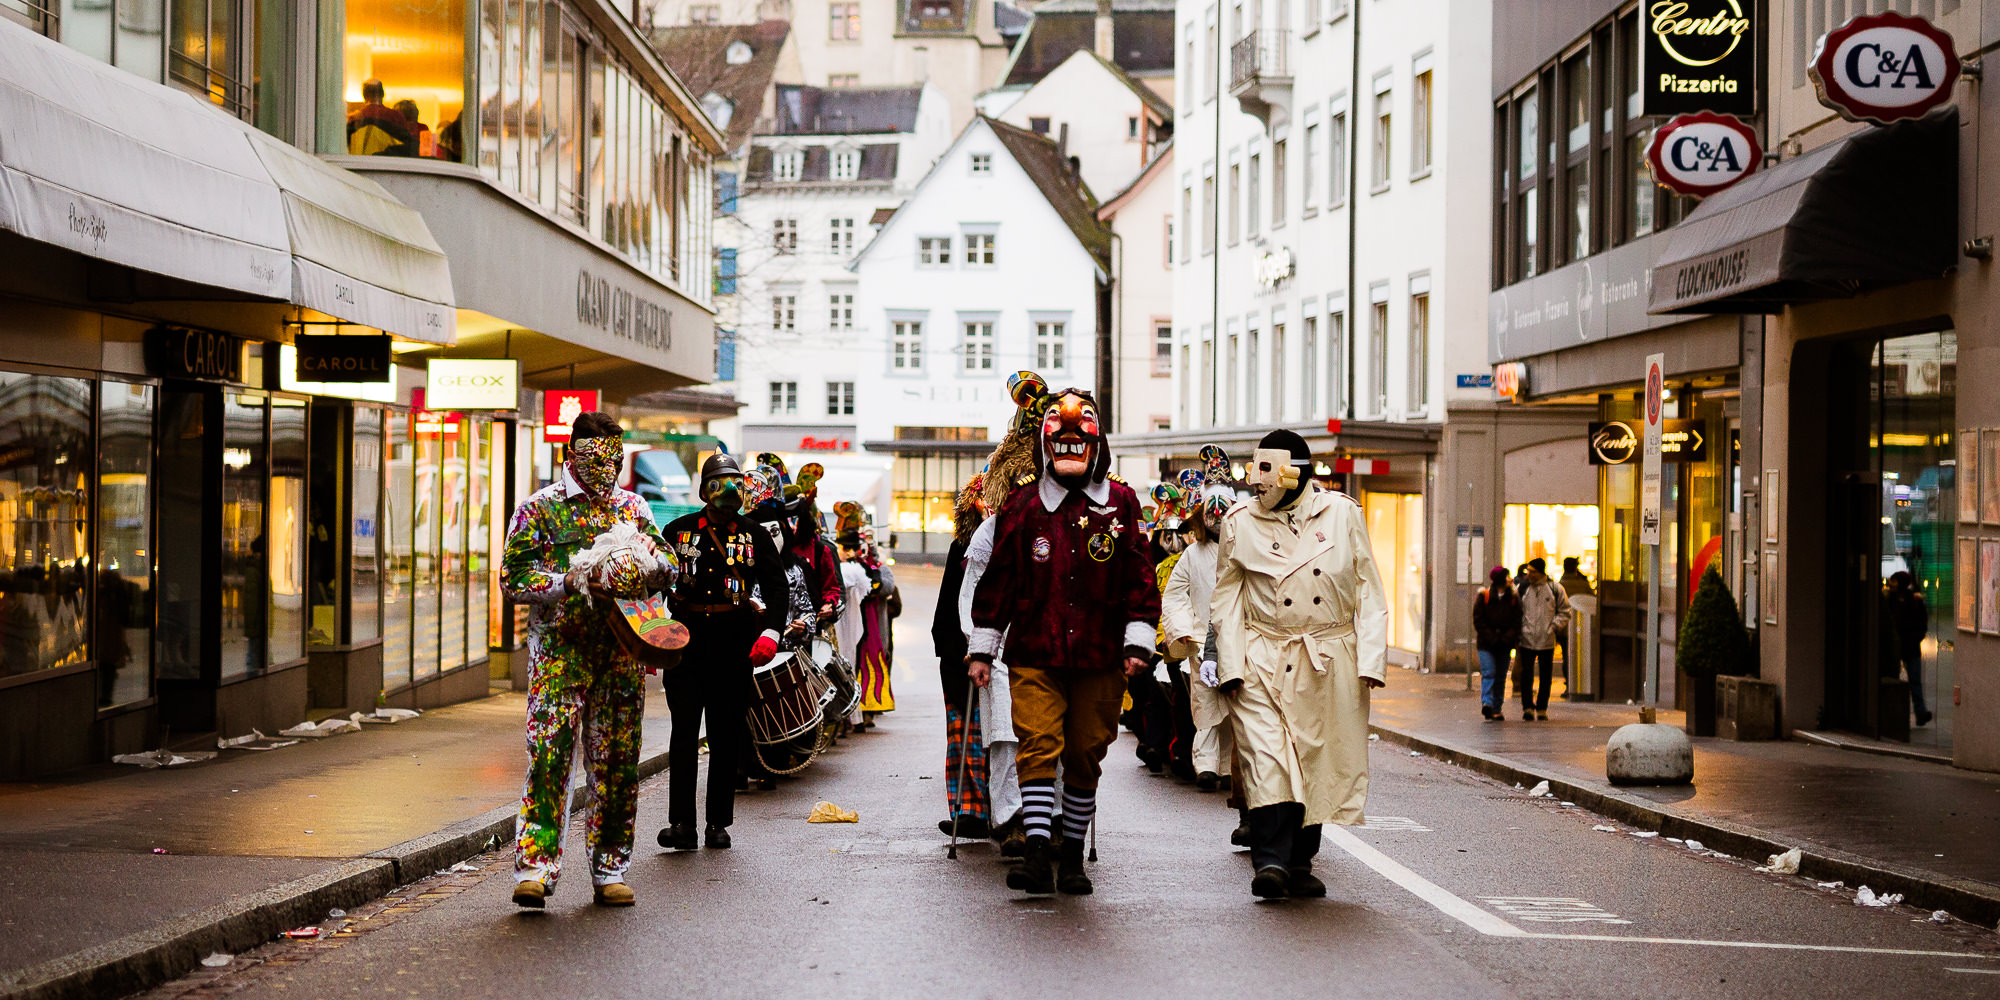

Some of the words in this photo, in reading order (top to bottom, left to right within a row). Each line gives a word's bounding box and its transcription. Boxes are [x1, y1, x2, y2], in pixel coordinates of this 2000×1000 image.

[1650, 0, 1750, 37] Centro
[1844, 42, 1936, 90] C&A
[1659, 74, 1738, 94] Pizzeria
[1670, 136, 1743, 173] C&A
[1675, 249, 1746, 301] CLOCKHOUSE
[1602, 276, 1638, 305] Ristorante
[303, 356, 380, 371] CAROLL
[437, 375, 505, 387] GEOX
[1592, 430, 1638, 450] Centro
